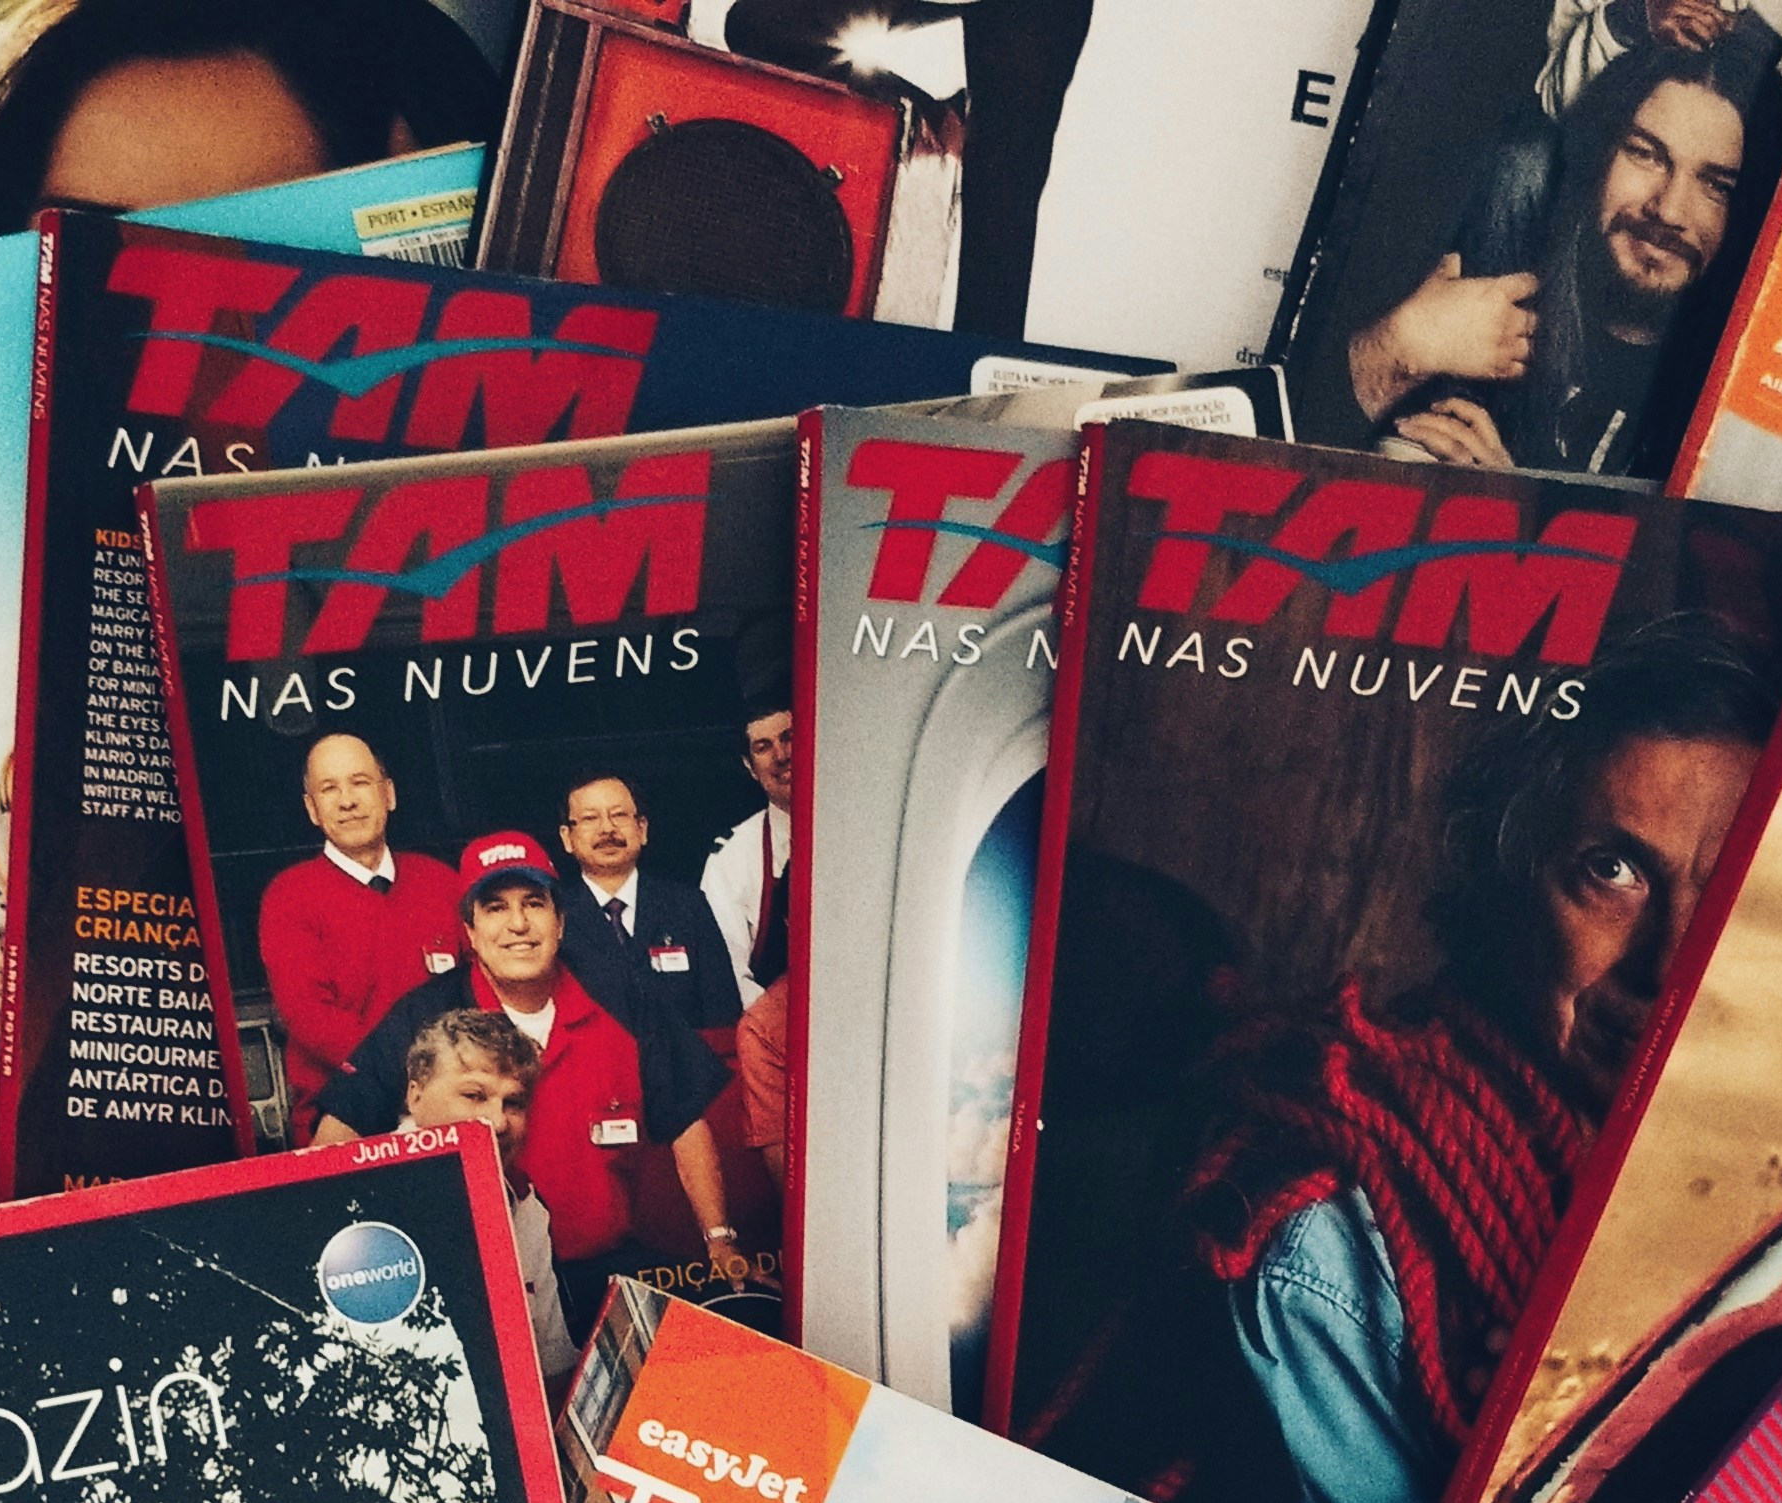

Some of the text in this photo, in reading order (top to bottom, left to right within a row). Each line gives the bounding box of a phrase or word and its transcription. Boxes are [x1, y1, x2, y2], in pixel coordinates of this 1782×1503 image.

[106, 246, 658, 450] TAM
[107, 428, 256, 478] NAS
[192, 450, 711, 663] TAM
[1128, 452, 1638, 667] TAM
[93, 586, 122, 603] THE
[91, 623, 144, 641] HARRY
[852, 615, 985, 667] NAS
[89, 640, 146, 659] ON THE
[87, 675, 118, 692] FOR
[220, 628, 704, 722] NAS NUVENS
[1119, 624, 1255, 679] NAS
[1293, 646, 1587, 722] NUVENS
[86, 711, 160, 733] THE EYES
[84, 747, 135, 766] MARIO
[82, 783, 142, 802] WRITER
[81, 801, 130, 818] STAFF
[75, 916, 201, 950] CRIANÇA
[74, 952, 182, 982] RESORTS
[72, 982, 214, 1013] NORTE BAIA
[69, 1066, 200, 1098] ANTÁRTICA
[67, 1096, 174, 1124] DE AMYR
[352, 1127, 459, 1165] Juni 2014
[327, 1258, 418, 1291] oneworld
